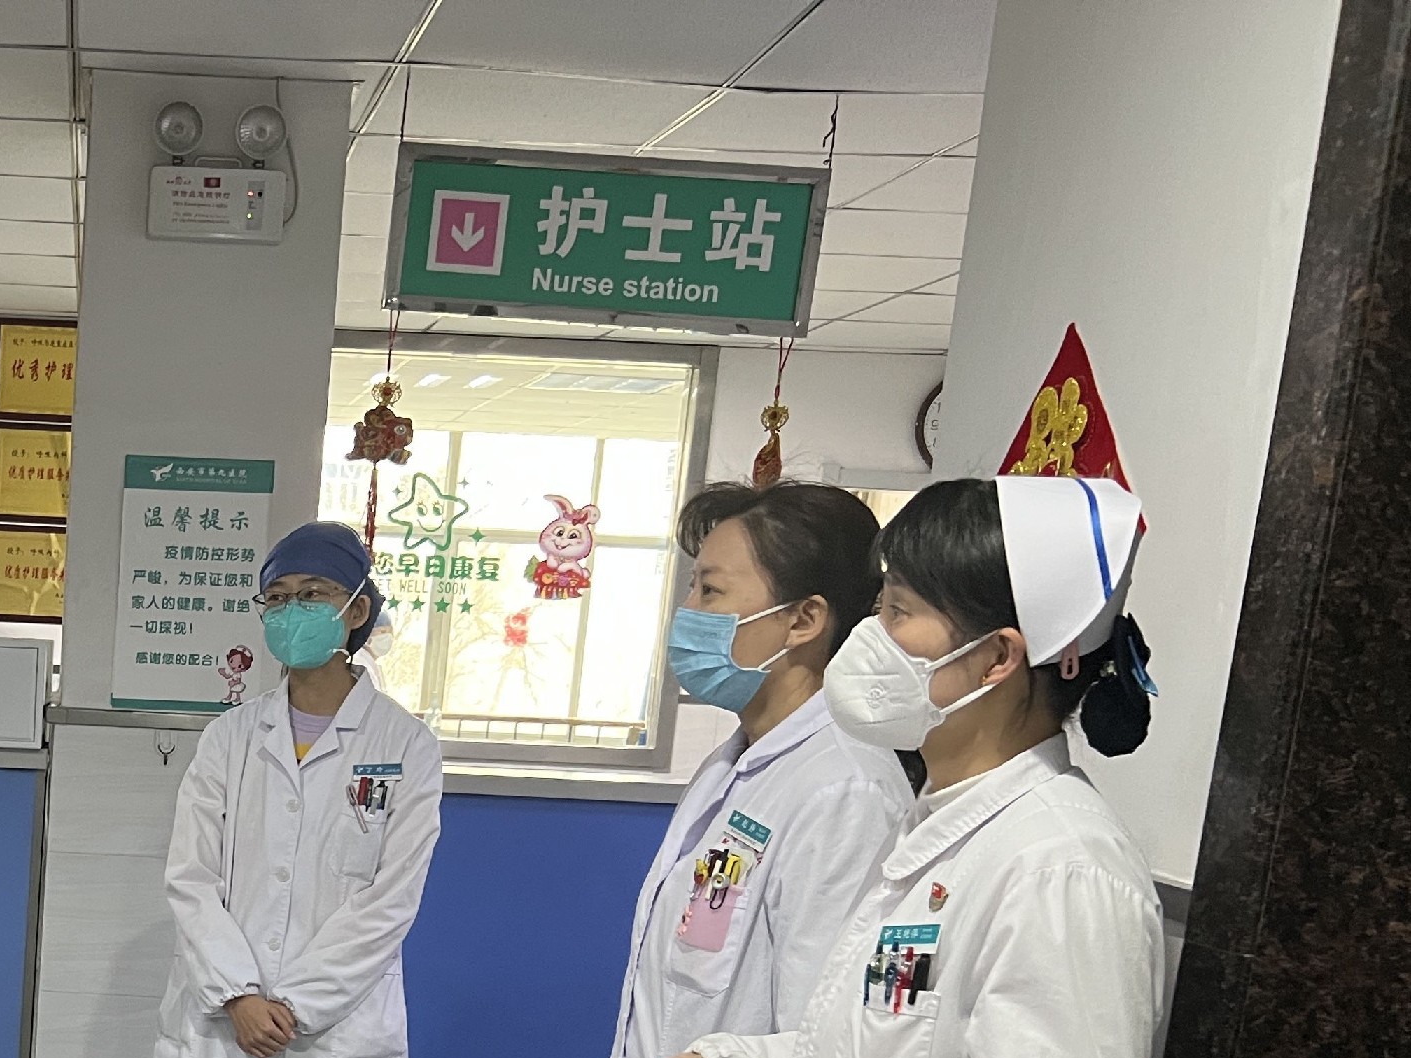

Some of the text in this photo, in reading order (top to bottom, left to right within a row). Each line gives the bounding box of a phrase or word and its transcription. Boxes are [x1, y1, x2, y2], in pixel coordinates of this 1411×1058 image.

[537, 185, 781, 271] 护士站
[532, 268, 718, 303] Nurse station
[144, 505, 251, 532] 温馨提示
[164, 546, 255, 563] 疫情防控形势
[131, 570, 254, 588] 严峻，为保证您和
[399, 578, 428, 593] WELL
[437, 581, 467, 595] SOON
[131, 595, 251, 613] 家人的健康。谢绝
[130, 620, 193, 635] 一切探视！
[135, 651, 219, 666] 感谢您的配合！
